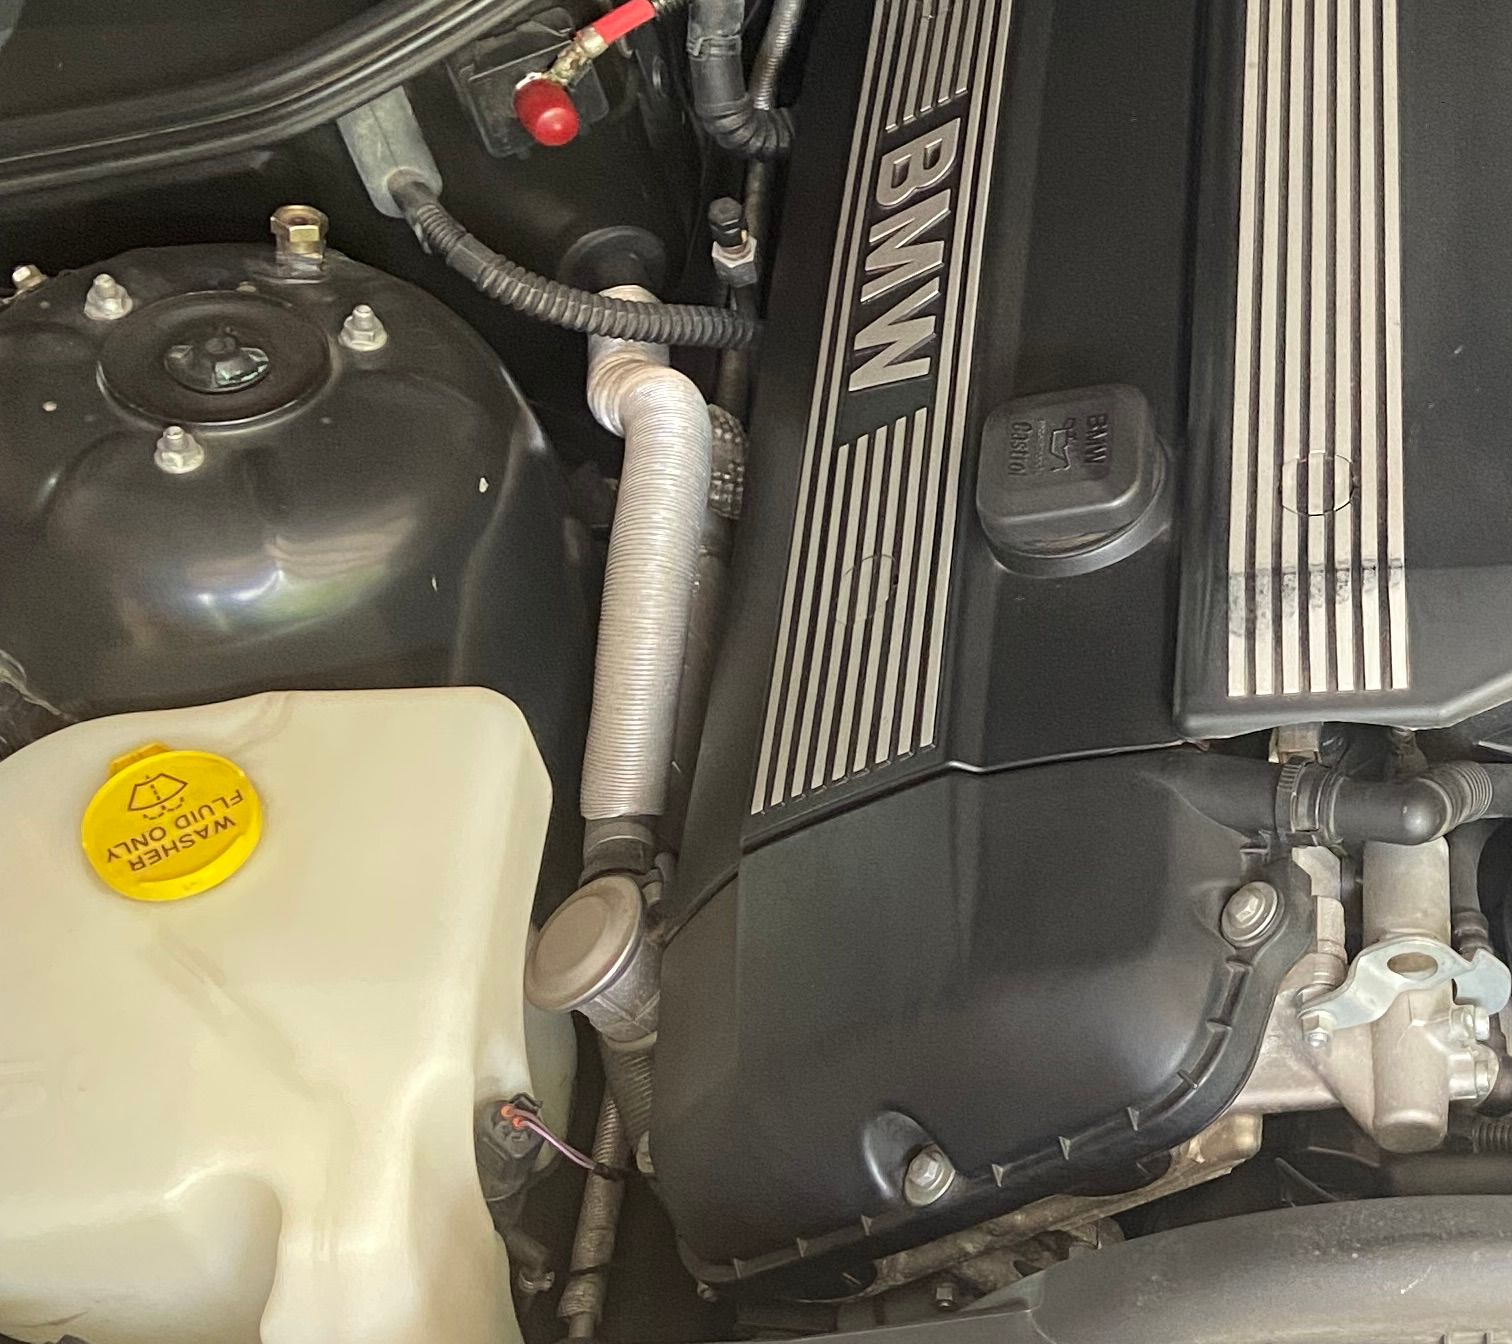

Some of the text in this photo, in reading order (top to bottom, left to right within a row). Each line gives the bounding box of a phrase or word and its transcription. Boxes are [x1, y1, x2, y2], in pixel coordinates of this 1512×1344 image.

[849, 117, 961, 392] BMW
[1008, 422, 1033, 476] Castrol
[1084, 414, 1108, 463] BMW
[106, 789, 244, 863] FLUID ONLY
[128, 815, 236, 871] WASHER
